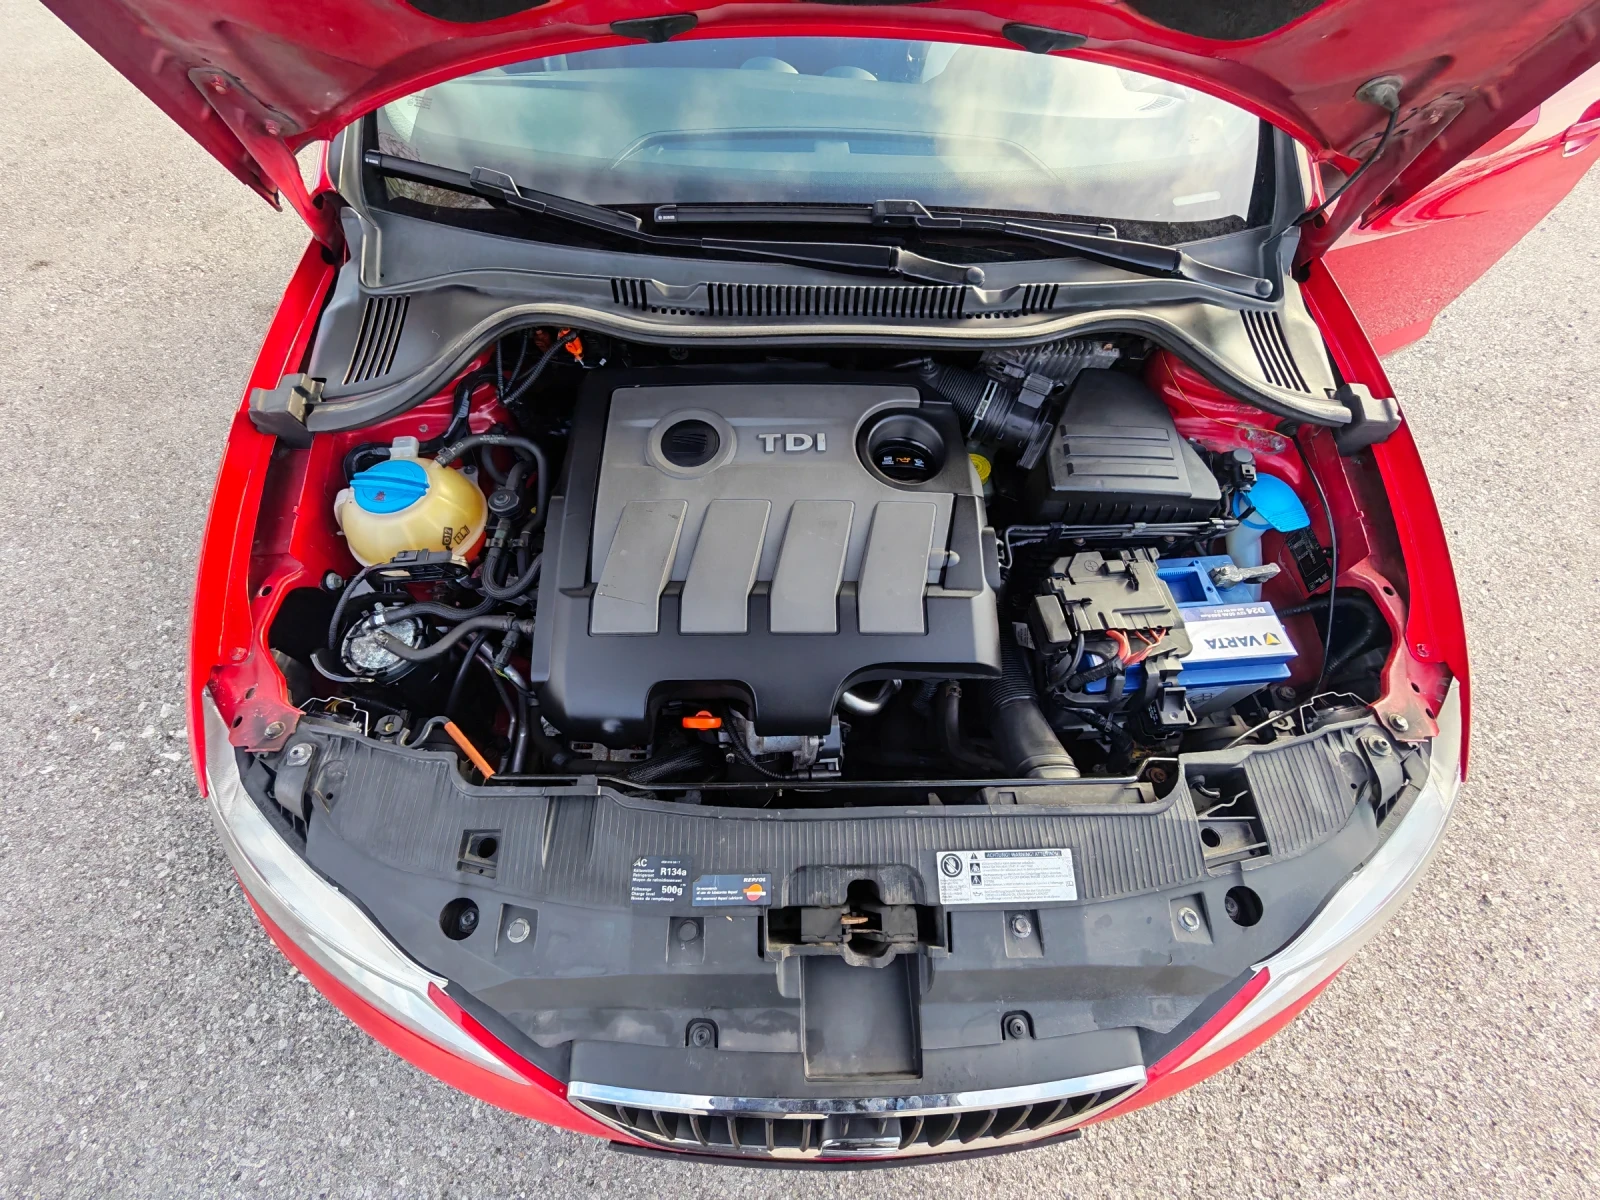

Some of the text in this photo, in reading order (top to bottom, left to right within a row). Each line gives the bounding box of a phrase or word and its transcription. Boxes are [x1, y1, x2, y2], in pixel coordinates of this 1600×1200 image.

[758, 432, 826, 452] TDI
[1204, 635, 1262, 650] VARTA
[633, 857, 648, 867] AC
[660, 867, 687, 876] R134a
[661, 885, 683, 896] 500g
